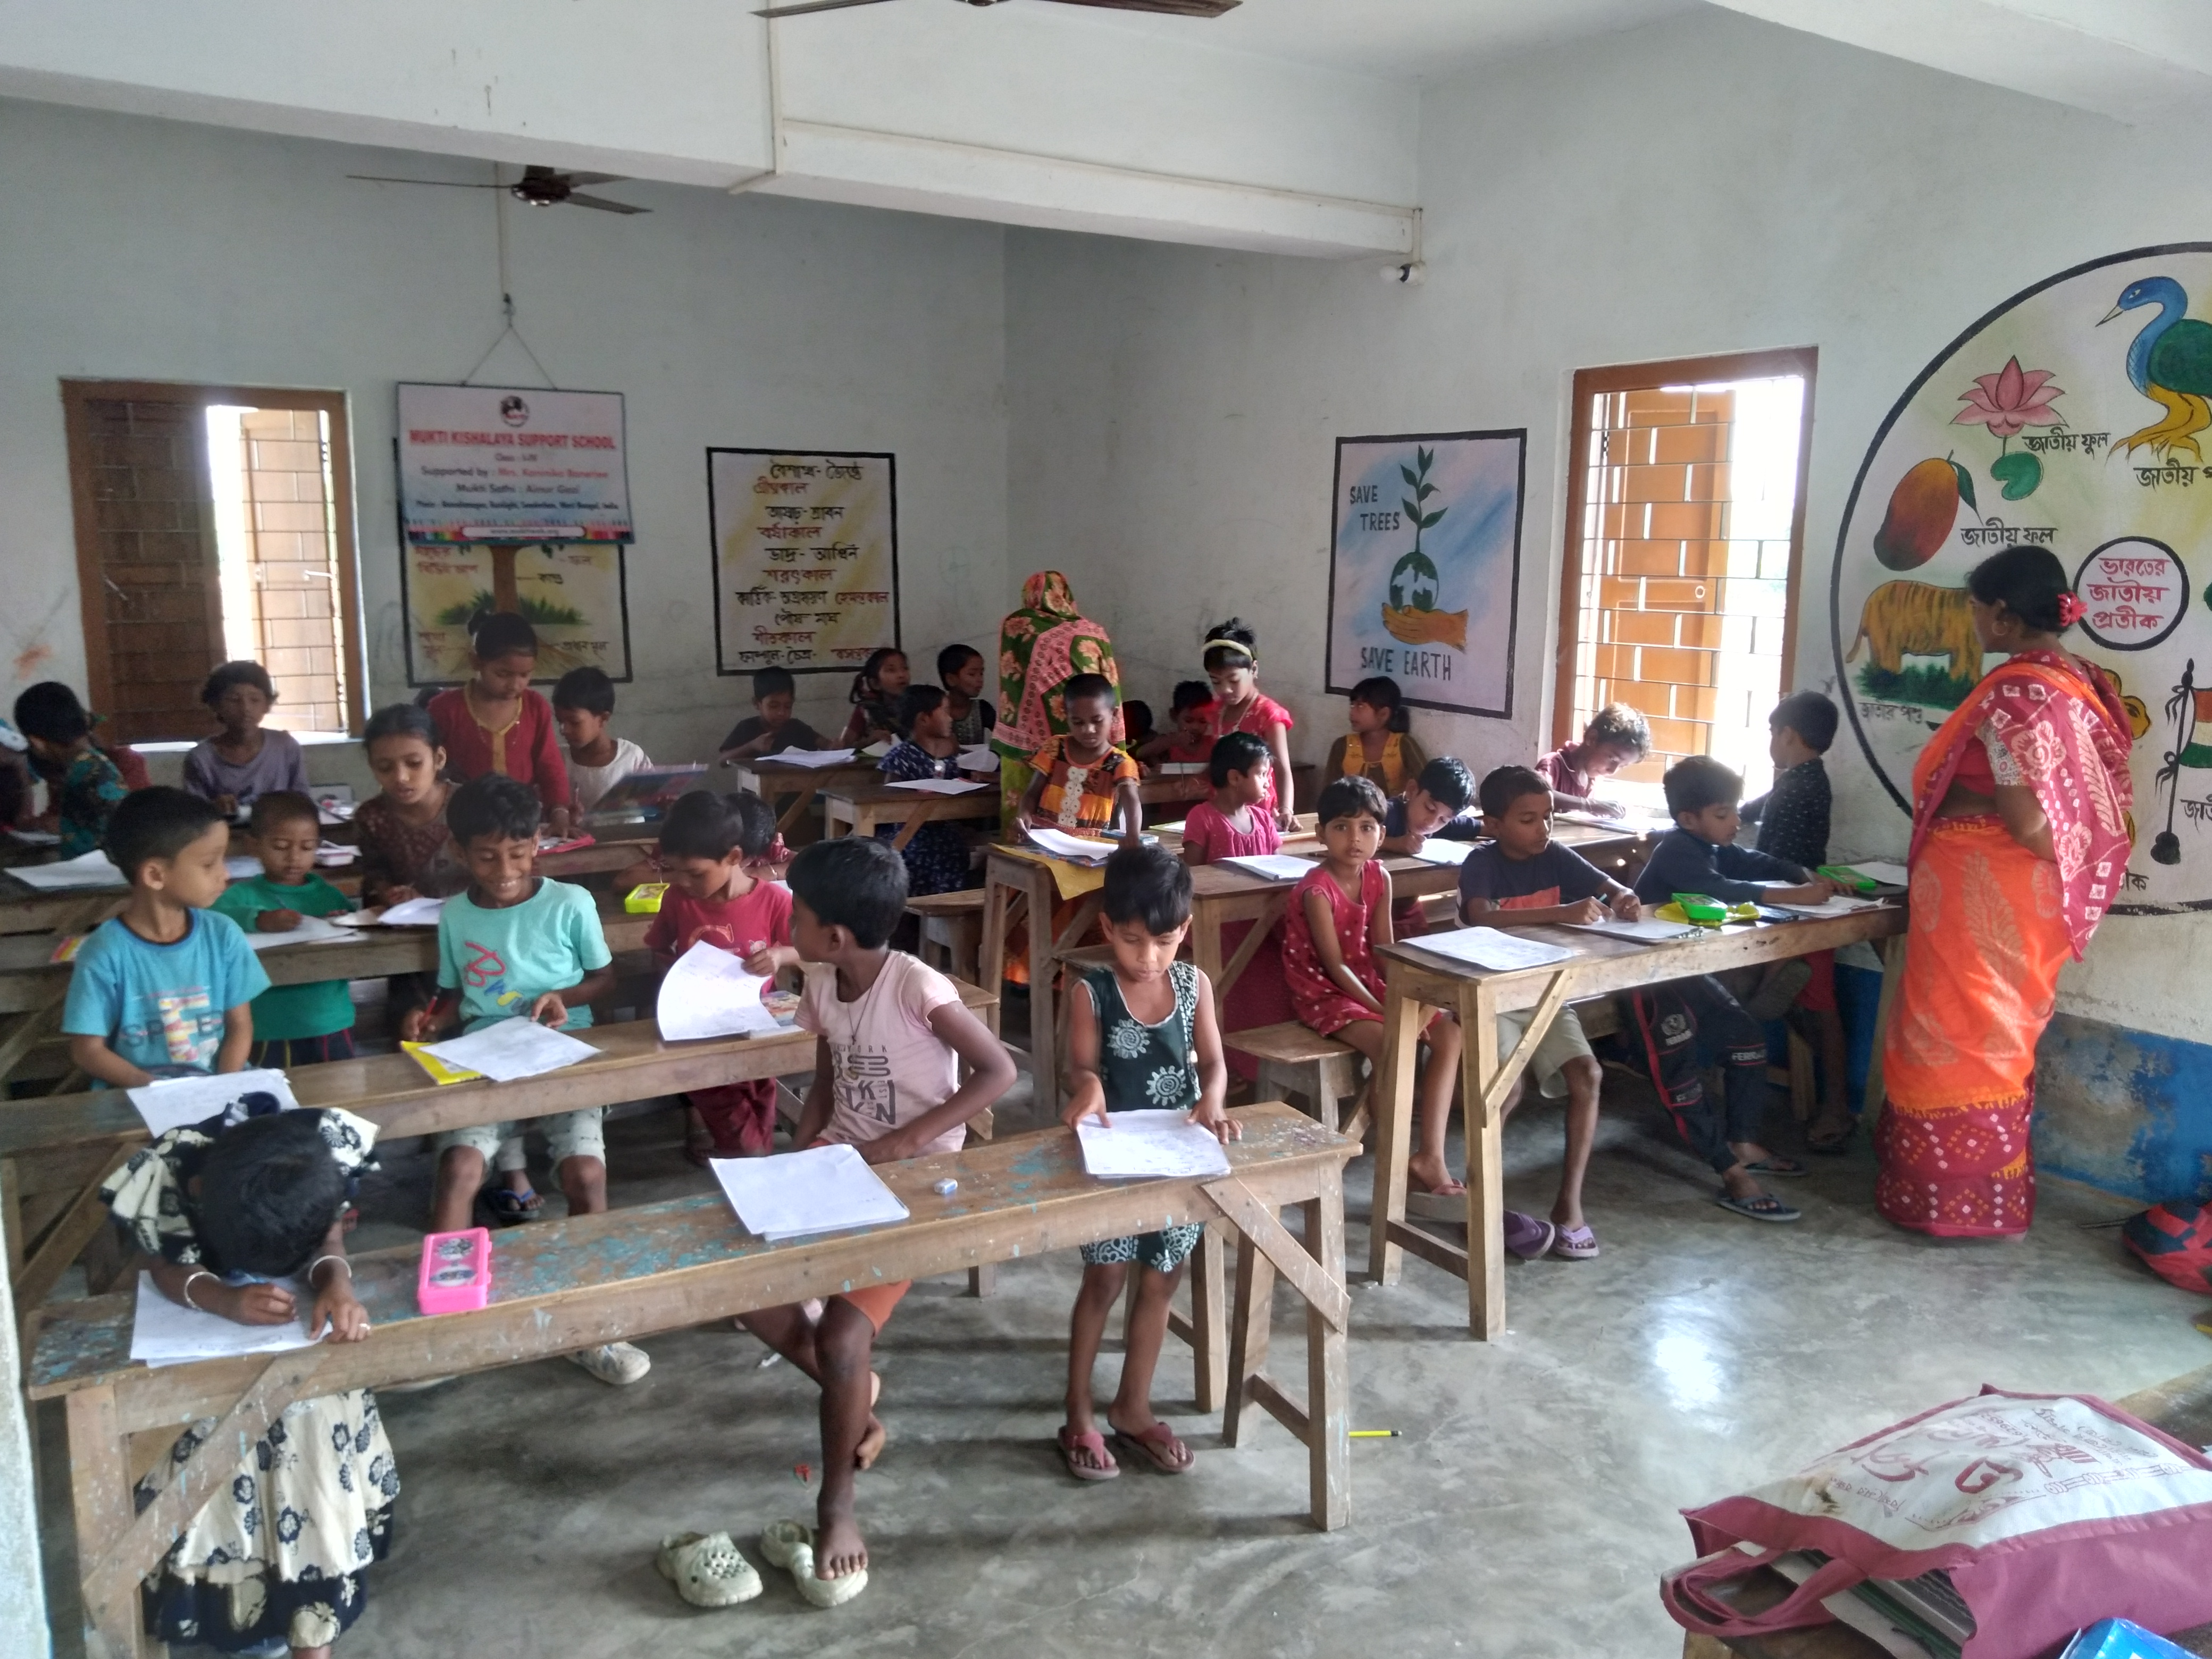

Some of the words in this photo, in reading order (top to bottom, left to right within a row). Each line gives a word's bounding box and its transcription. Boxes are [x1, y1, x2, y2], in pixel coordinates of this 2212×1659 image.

[518, 433, 568, 448] SUPPORT
[572, 435, 615, 449] SCHOOL
[2022, 426, 2079, 455] জাতীয়
[2080, 431, 2112, 459] ফুল
[2133, 457, 2200, 493] জাতীয়
[1350, 484, 1378, 505] SAVE
[1360, 511, 1401, 531] TREES
[1960, 516, 2021, 548] জাতীয়
[2022, 526, 2058, 544] ফল
[2098, 557, 2171, 577] ভারতের
[2086, 576, 2171, 603] জাতীয়
[2092, 605, 2163, 631] প্রতীক
[1361, 647, 1394, 673] SAVE
[1404, 650, 1452, 681] EARTH
